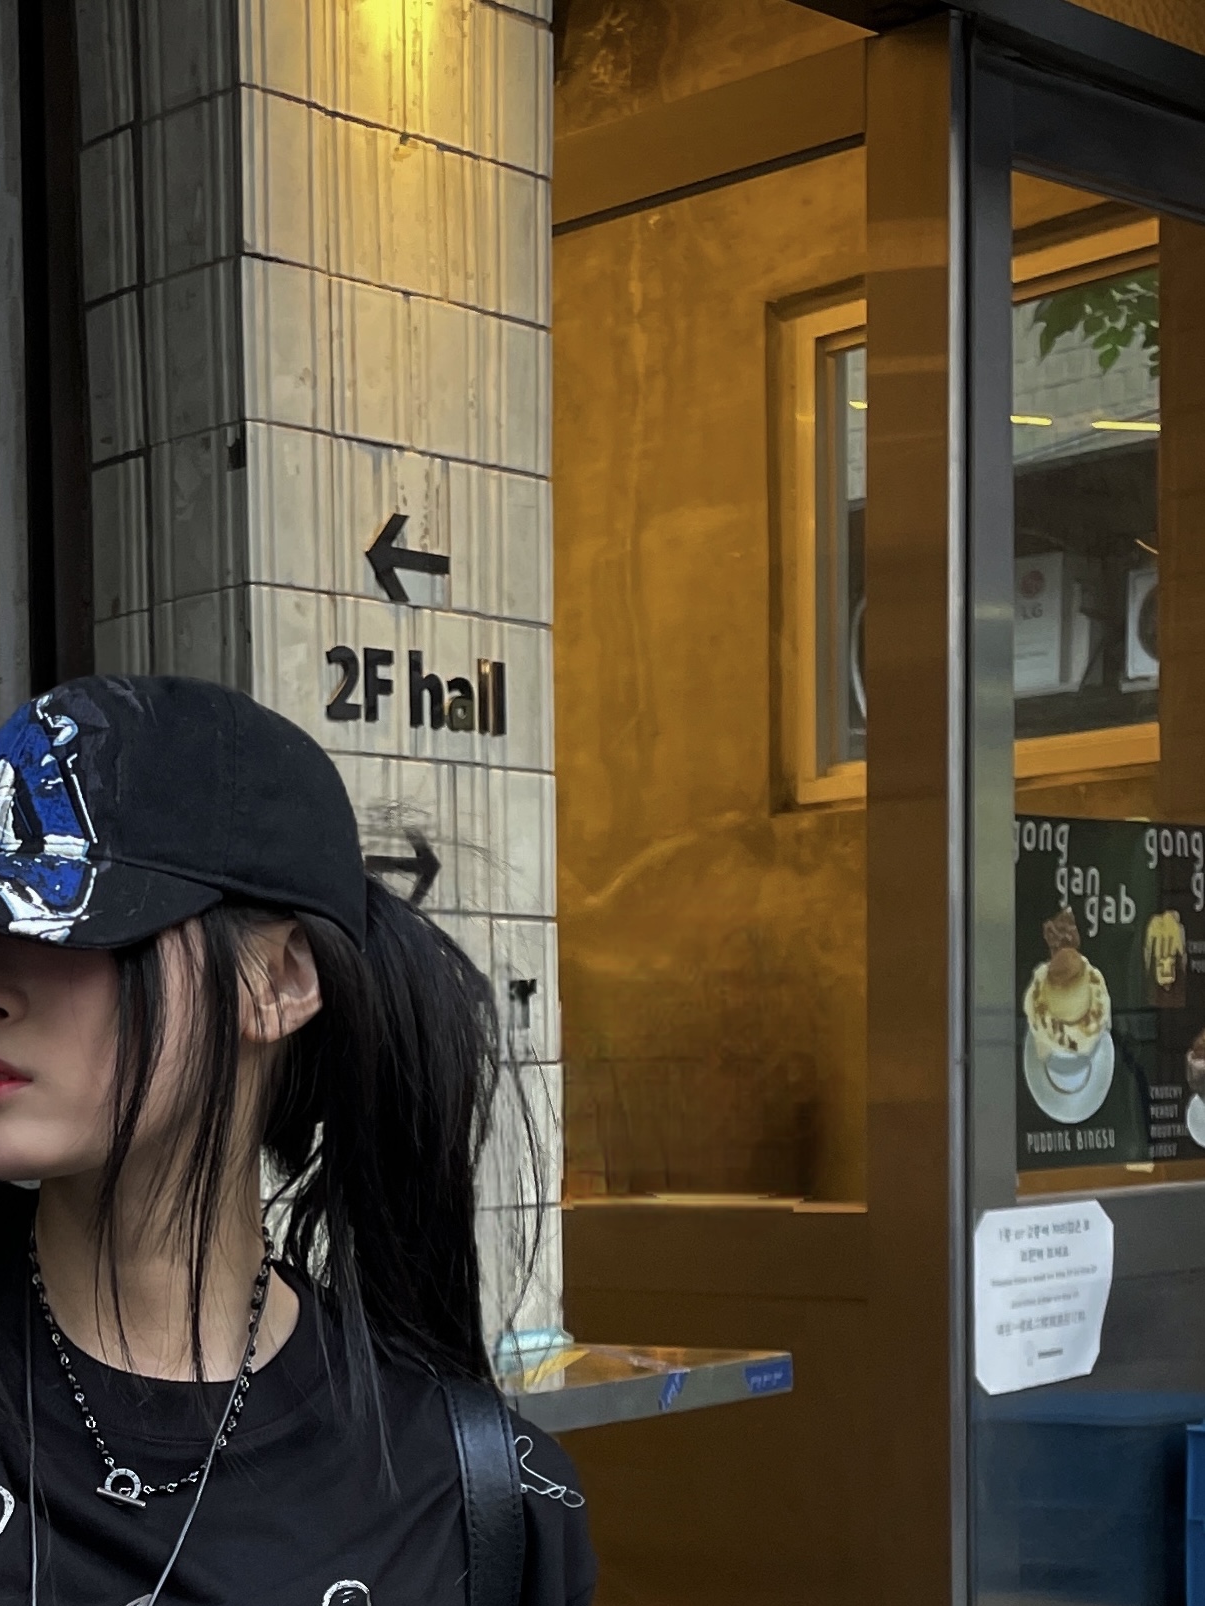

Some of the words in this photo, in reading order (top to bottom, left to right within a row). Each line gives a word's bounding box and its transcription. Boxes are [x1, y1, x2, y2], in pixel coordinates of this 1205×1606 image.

[325, 645, 395, 722] 2F
[408, 650, 507, 736] hall
[1143, 827, 1204, 872] gong
[1055, 866, 1100, 908] gan
[1084, 883, 1136, 937] gab
[1026, 1130, 1071, 1154] PUDDING
[1076, 1127, 1115, 1151] BINGSU
